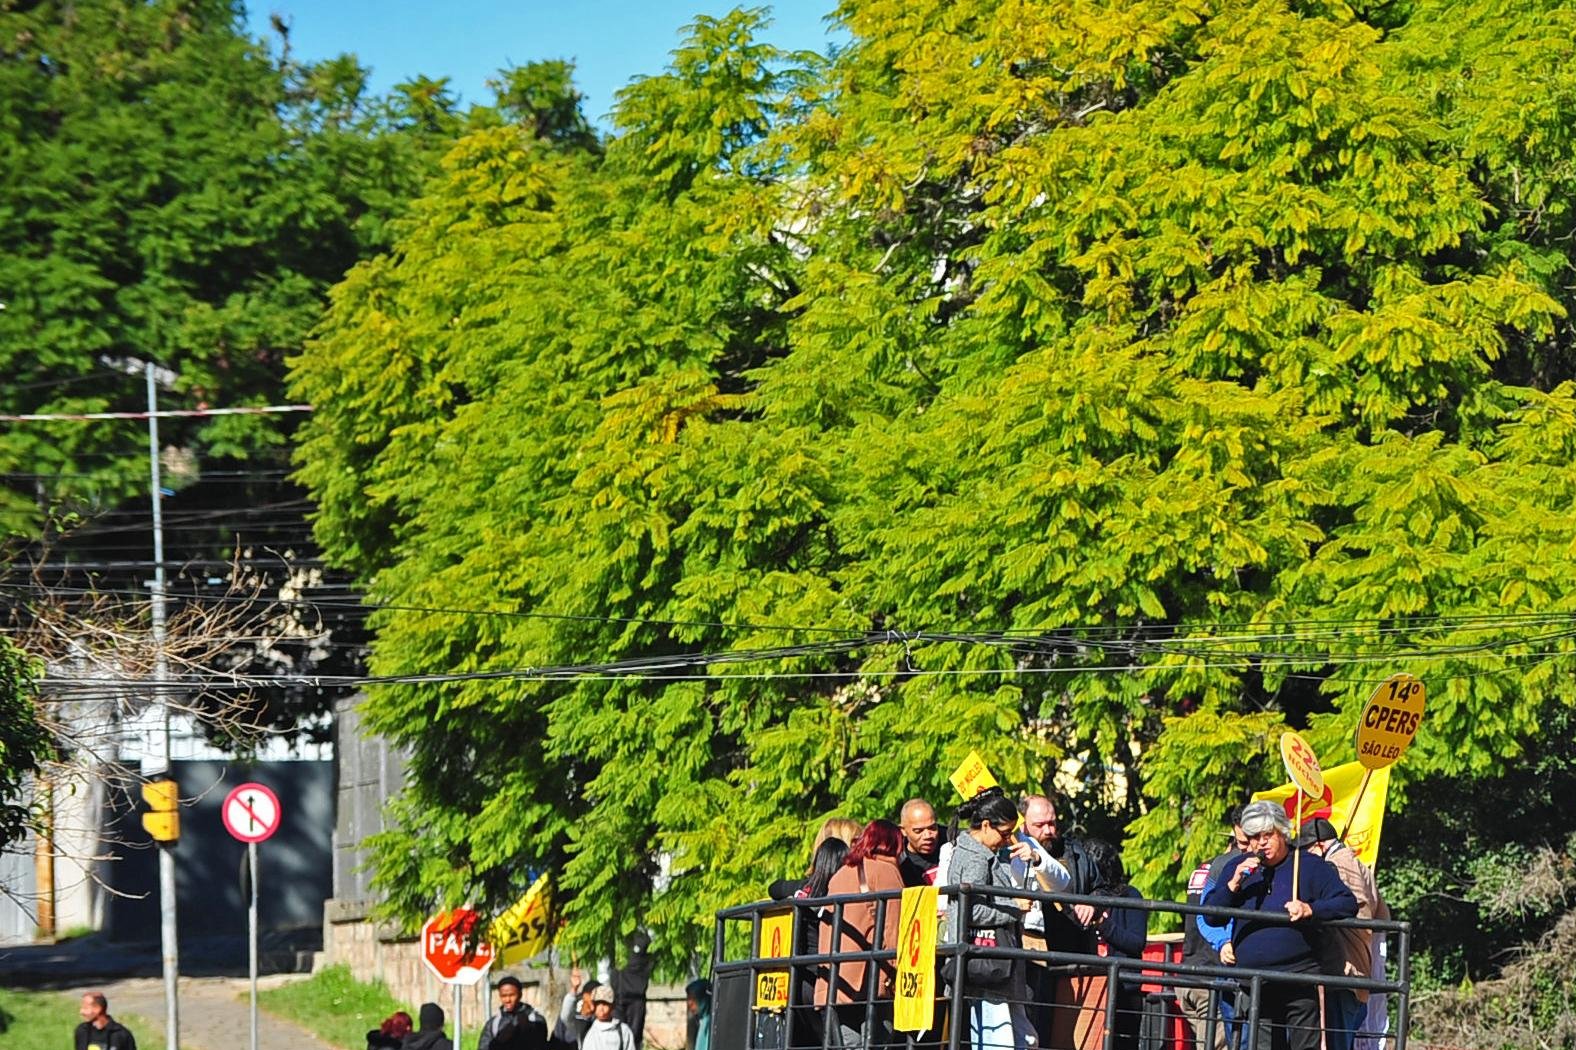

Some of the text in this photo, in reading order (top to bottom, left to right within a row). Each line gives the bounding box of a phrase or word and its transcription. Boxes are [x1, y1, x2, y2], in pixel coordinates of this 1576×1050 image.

[1365, 705, 1420, 735] CPERS
[1361, 740, 1400, 760] SÃO LÉO
